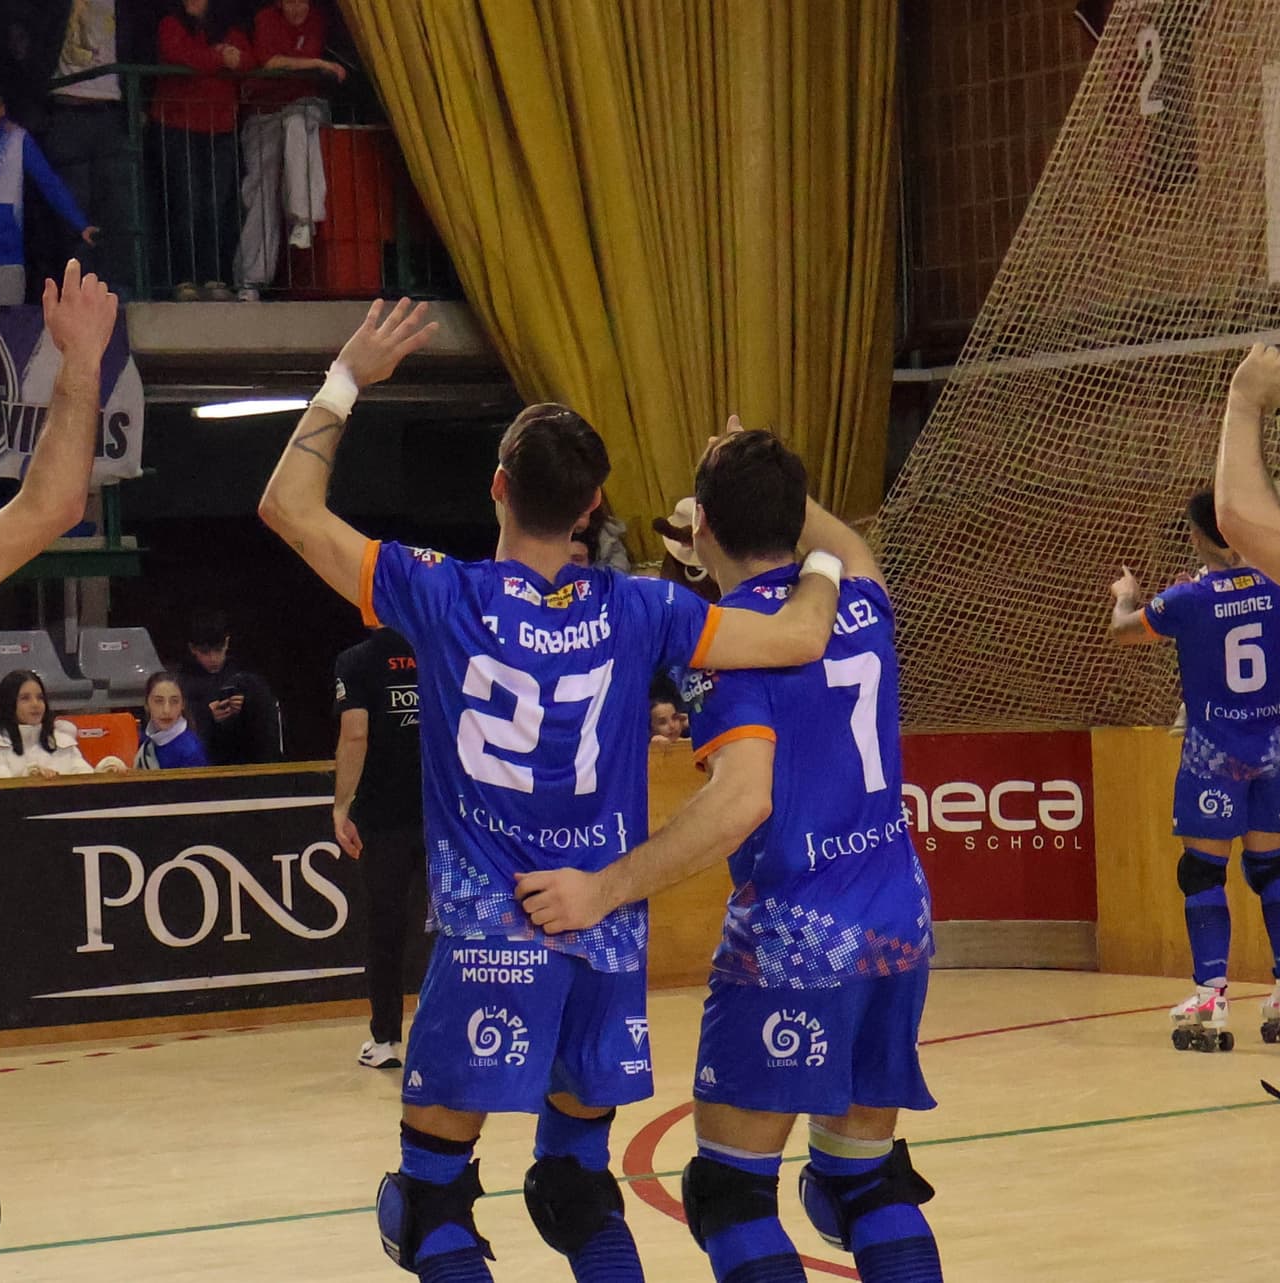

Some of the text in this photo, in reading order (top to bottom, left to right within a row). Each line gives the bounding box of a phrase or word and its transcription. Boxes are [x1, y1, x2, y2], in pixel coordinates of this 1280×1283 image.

[1214, 596, 1273, 618] GIMENEZ
[1224, 623, 1267, 693] 6
[457, 654, 614, 795] 27
[823, 651, 887, 793] 7
[1213, 706, 1248, 720] CLOS
[539, 824, 606, 849] PONS
[821, 828, 876, 860] CLOS
[964, 835, 1082, 850] SCHOOL
[72, 841, 349, 952] PONS
[453, 949, 548, 966] MITSUBISHI
[462, 968, 535, 984] MOTORS
[484, 1005, 530, 1067] L'APLEC
[782, 1009, 828, 1067] L'APLEC
